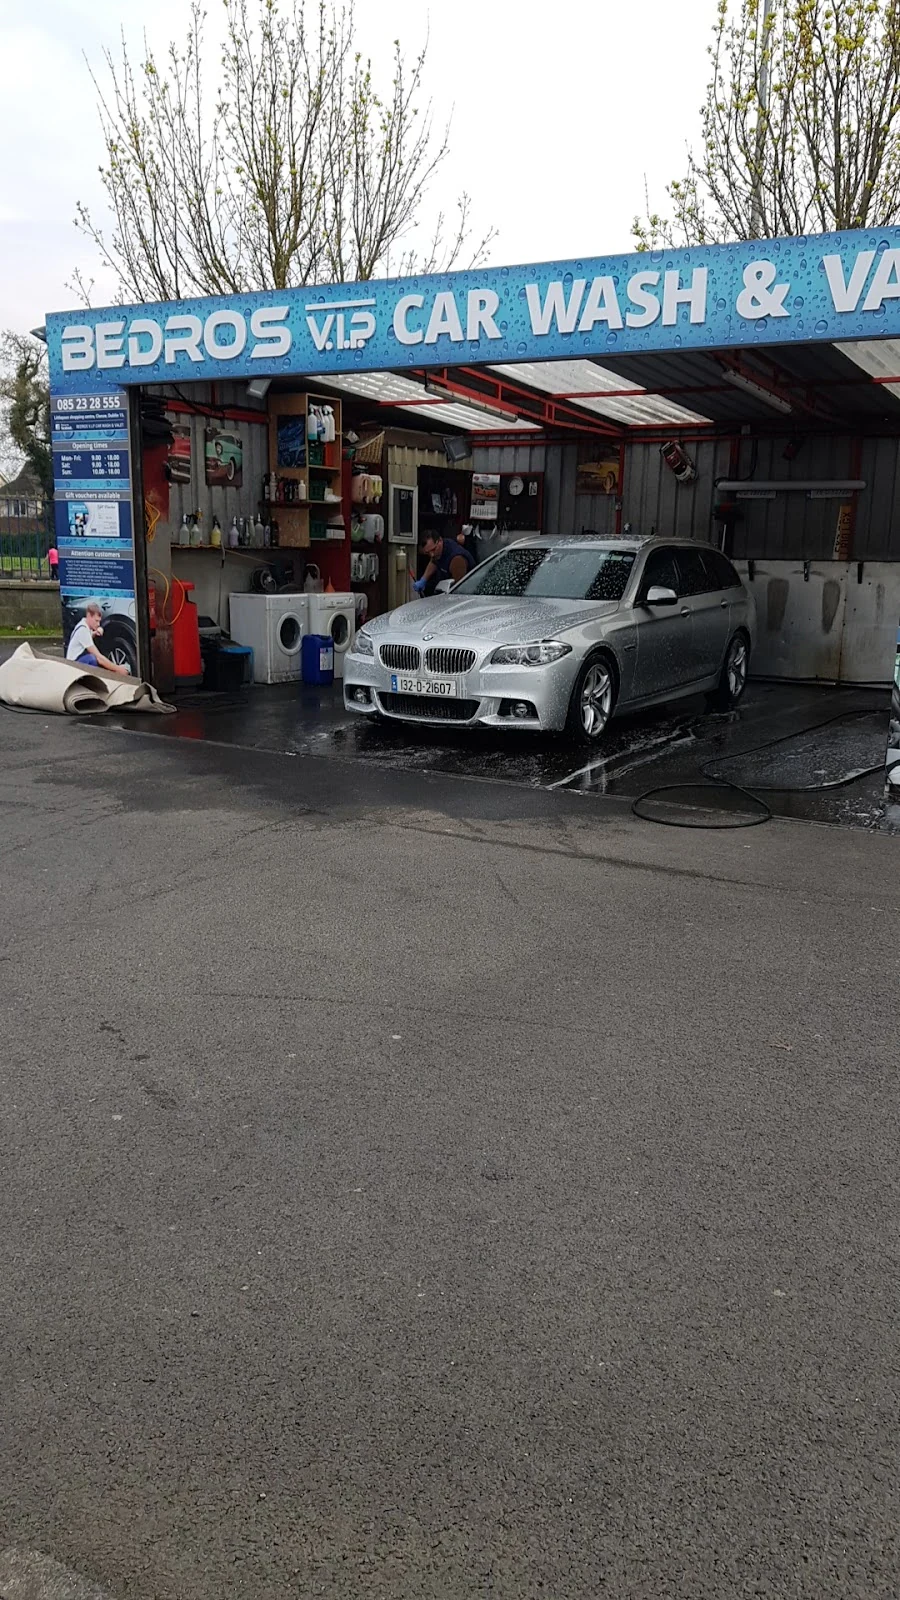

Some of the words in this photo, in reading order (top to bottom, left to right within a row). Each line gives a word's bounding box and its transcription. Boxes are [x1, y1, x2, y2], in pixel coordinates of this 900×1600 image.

[61, 305, 292, 371] BEDROS
[392, 287, 503, 345] CAR
[525, 266, 708, 336] WASH
[735, 260, 791, 320] &
[57, 399, 74, 410] 085
[76, 398, 88, 409] 23
[89, 397, 101, 409] 28
[102, 396, 121, 408] 555
[72, 442, 93, 451] Opening
[65, 491, 75, 499] Gift
[97, 491, 121, 499] available
[400, 679, 452, 695] 132-D-21607
